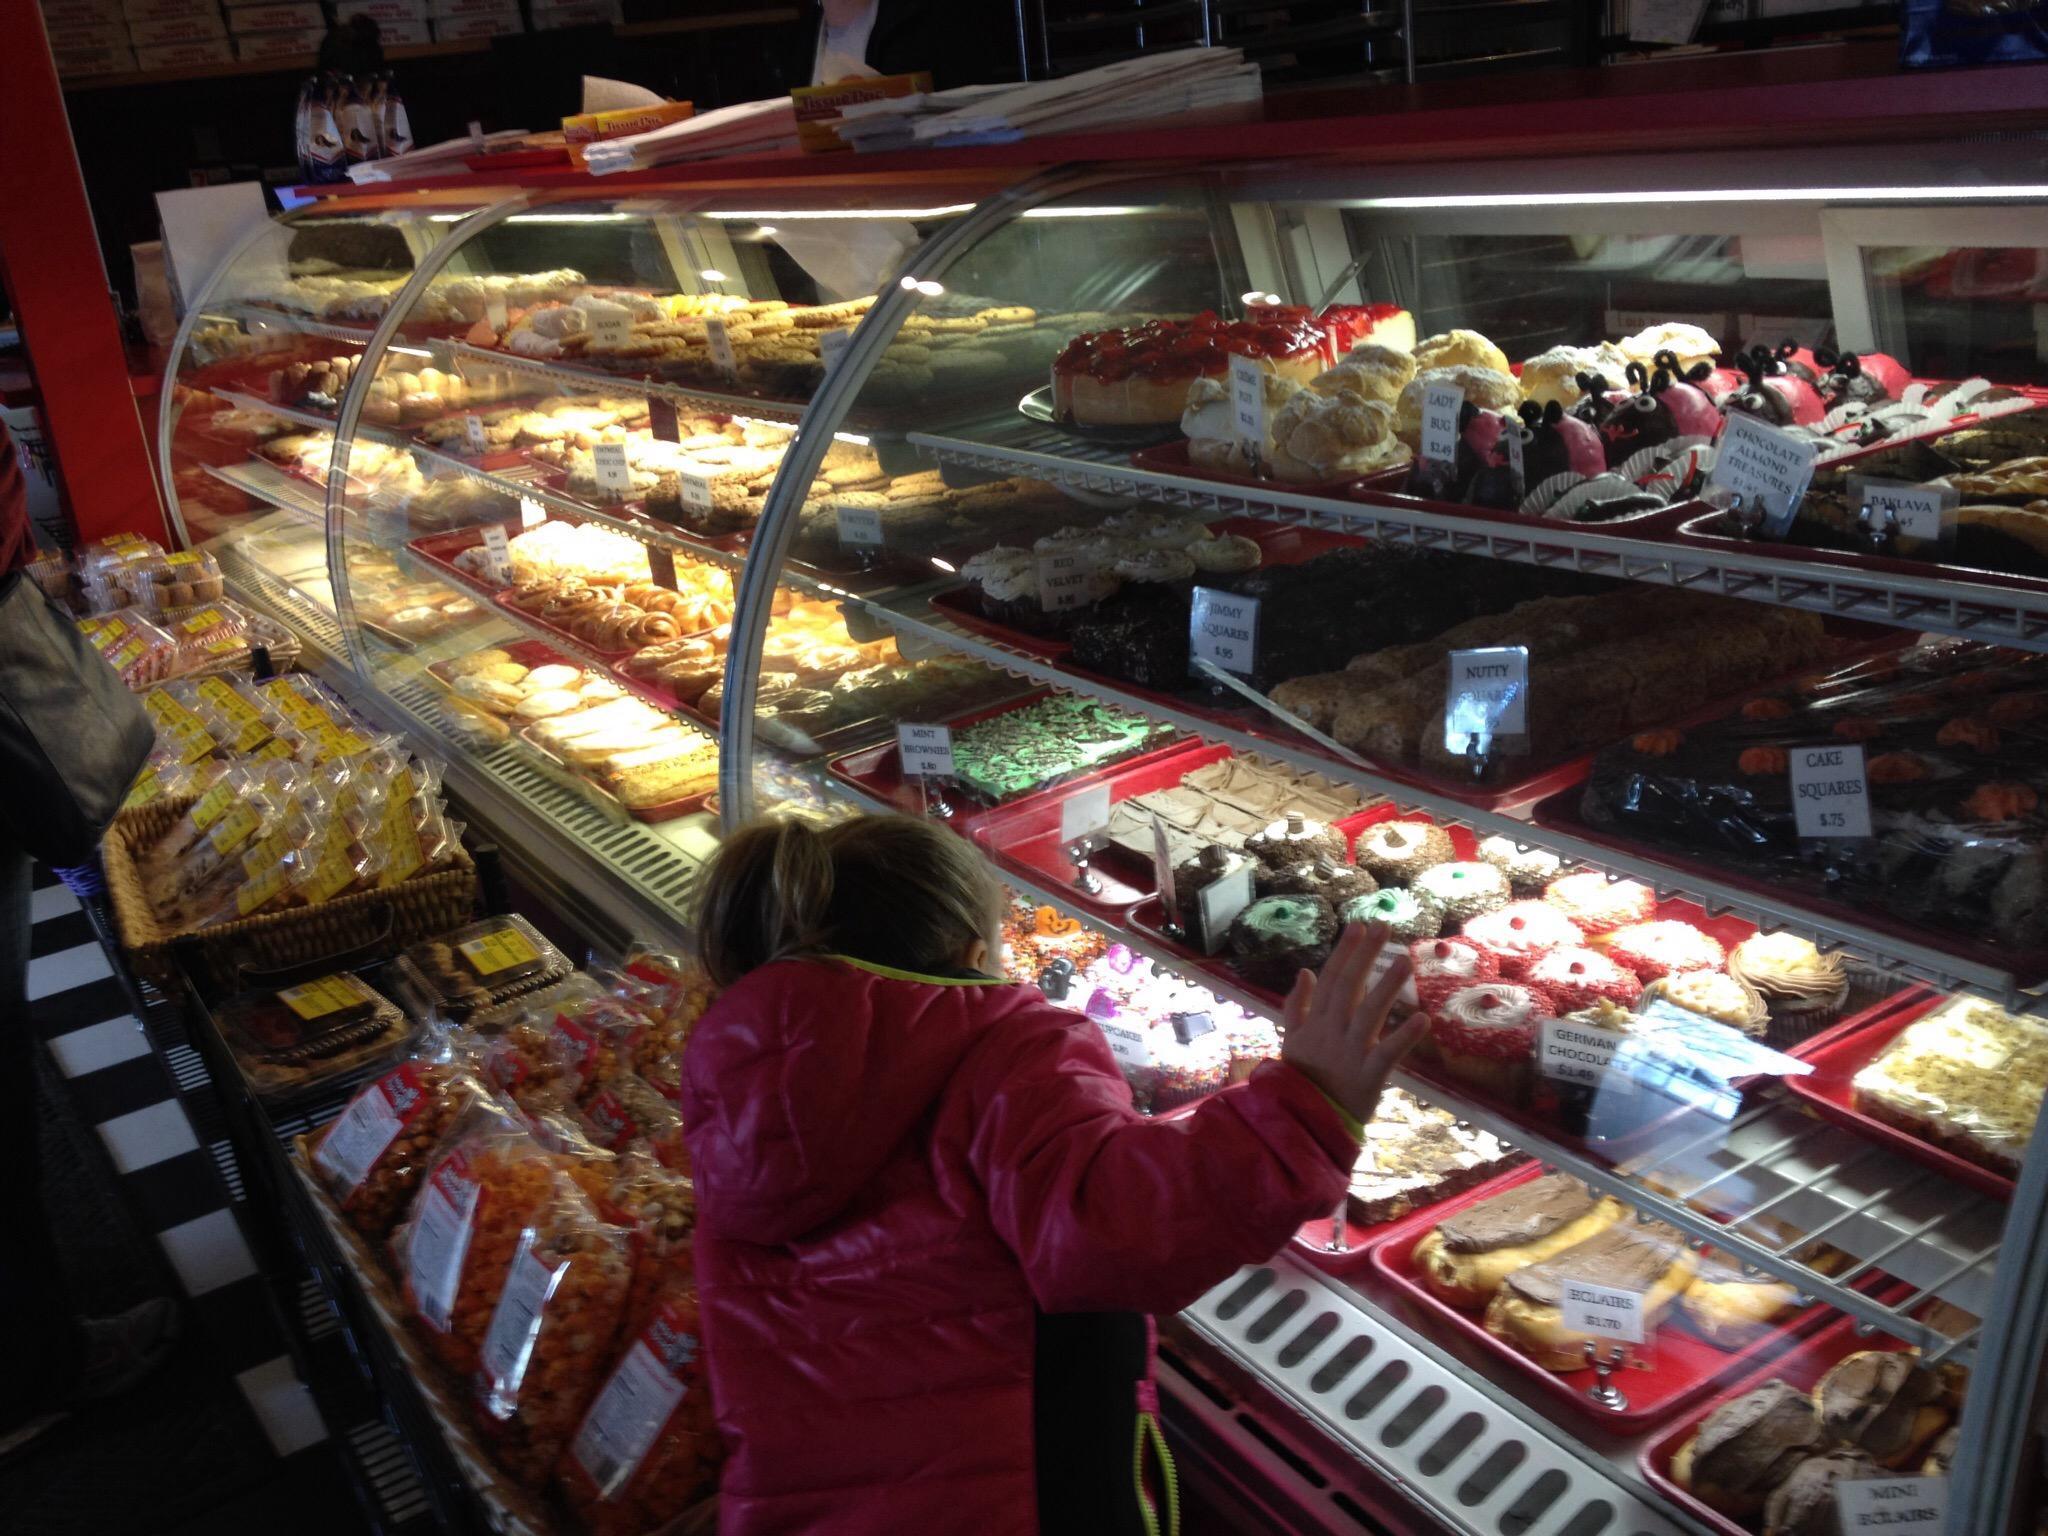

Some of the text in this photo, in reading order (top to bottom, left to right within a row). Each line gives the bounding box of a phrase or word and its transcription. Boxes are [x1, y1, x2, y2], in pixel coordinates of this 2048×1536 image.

[1428, 393, 1456, 409] LADY
[1430, 417, 1451, 431] BUG
[1430, 441, 1452, 456] $2.49
[1735, 427, 1803, 467] CHOCOLATE
[1736, 445, 1788, 476] ALMOND
[1727, 456, 1792, 494] TREASURES
[1053, 556, 1075, 569] RED
[1046, 574, 1084, 588] VELVET
[1208, 601, 1243, 620] JIMMY
[1200, 621, 1250, 642] SQUARES
[1215, 645, 1234, 660] $.95
[1466, 664, 1510, 680] NUTTY
[912, 728, 936, 739] MINT
[903, 743, 950, 755] BROWNIES
[1806, 750, 1844, 768] CAKE
[1798, 780, 1863, 801] SQUARES
[1819, 812, 1846, 827] $.75
[1555, 1028, 1617, 1051] GERMAN
[1567, 1288, 1635, 1310] ECLAIRS
[1868, 1484, 1919, 1501] MINI
[1855, 1507, 1940, 1526] ECLAIRS
